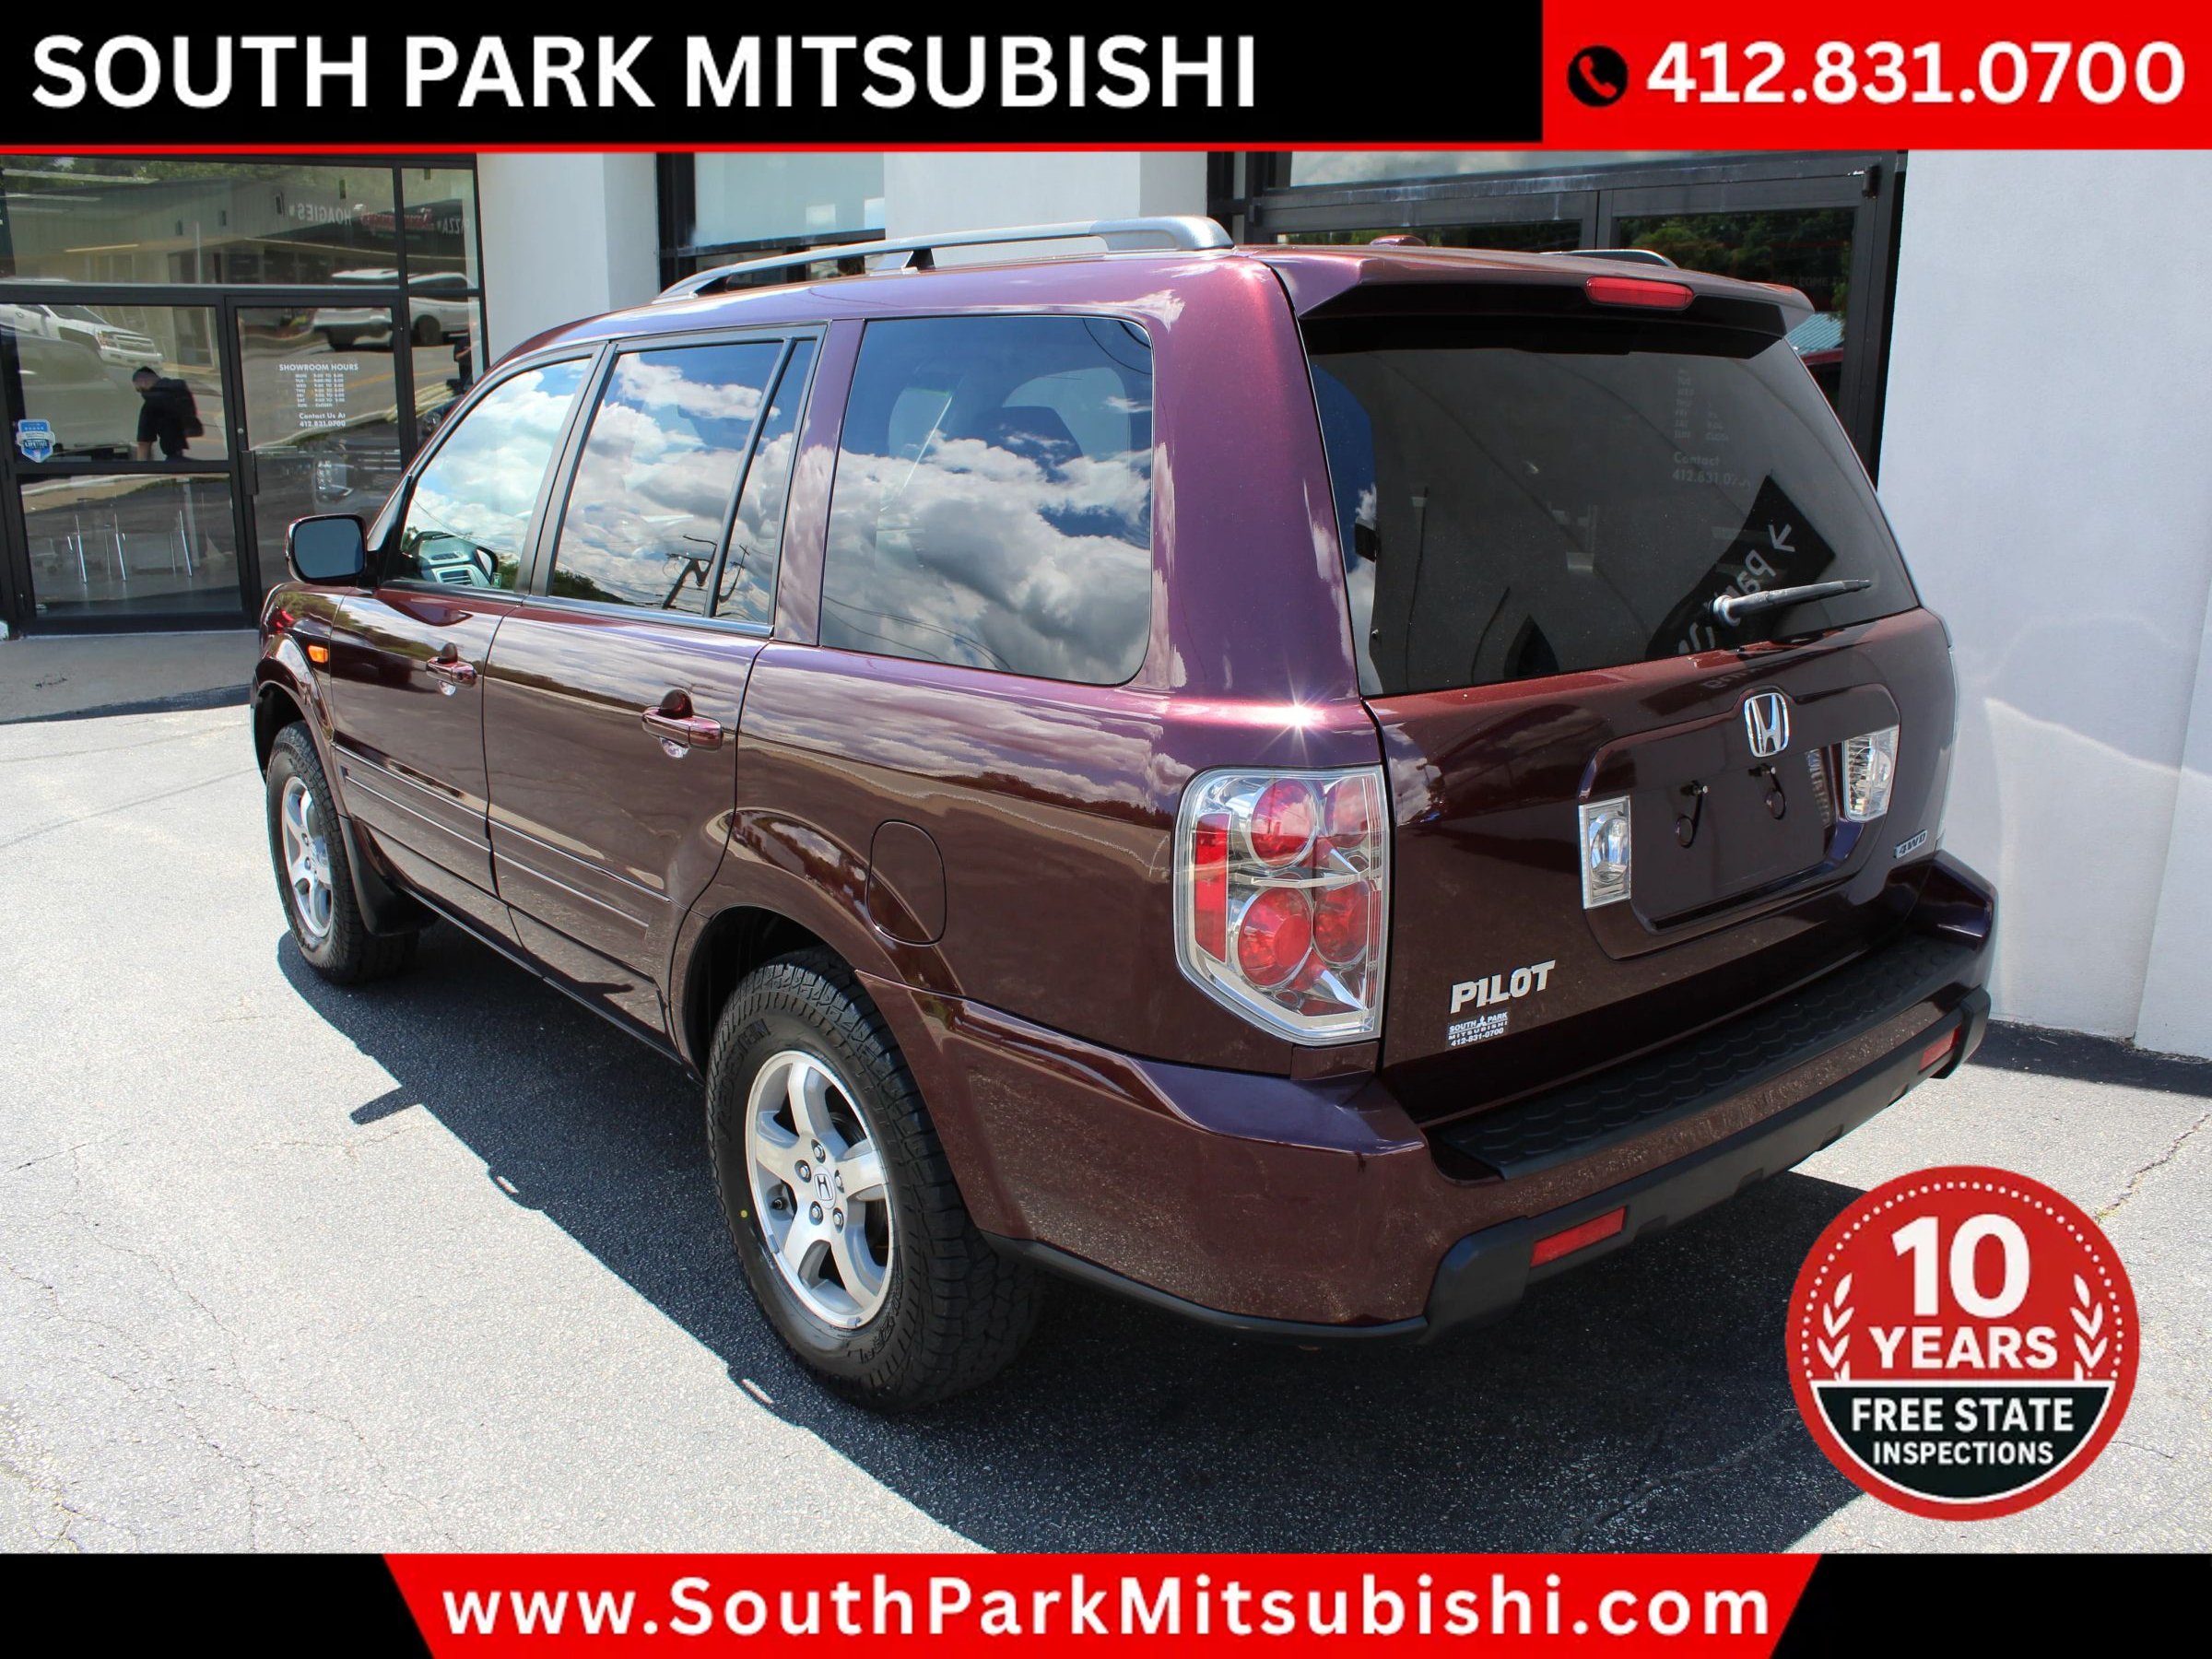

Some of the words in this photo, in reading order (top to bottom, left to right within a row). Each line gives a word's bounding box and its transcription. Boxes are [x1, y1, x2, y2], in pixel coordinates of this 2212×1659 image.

[279, 363, 329, 371] SHOWROOM
[1898, 831, 1926, 855] 4WD
[1450, 959, 1557, 1015] PILOT
[1448, 1019, 1477, 1033] SOUTH
[1487, 1011, 1509, 1024] PARK
[1448, 1020, 1509, 1041] MITSUBISHI
[1450, 1027, 1504, 1047] 412-831-0700
